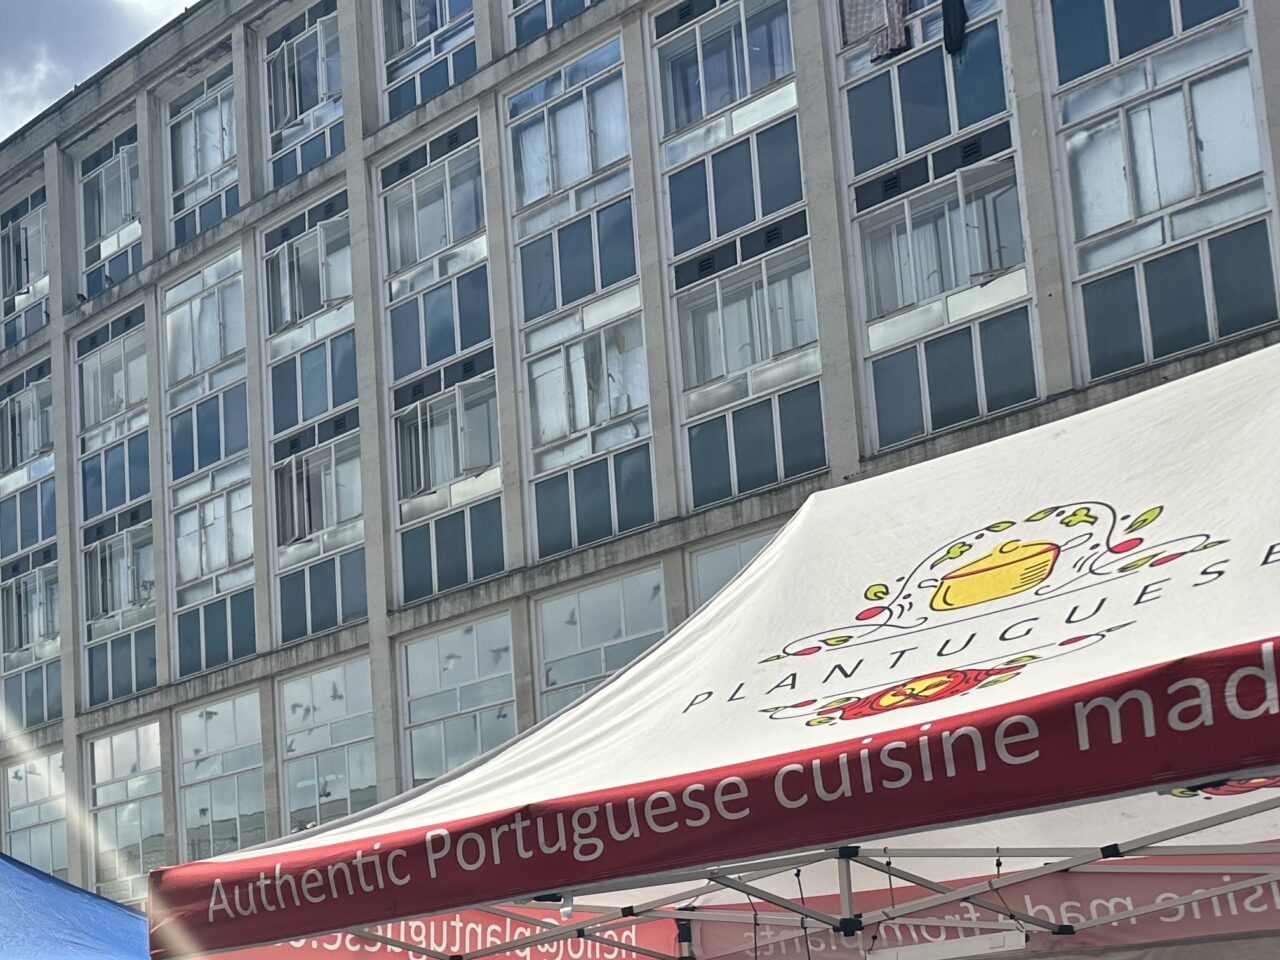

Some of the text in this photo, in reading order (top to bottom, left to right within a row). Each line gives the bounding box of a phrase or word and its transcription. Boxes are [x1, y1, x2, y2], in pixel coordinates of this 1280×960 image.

[208, 843, 410, 922] Authentic
[426, 770, 750, 878] Portuguese
[773, 722, 1040, 804] cuisine
